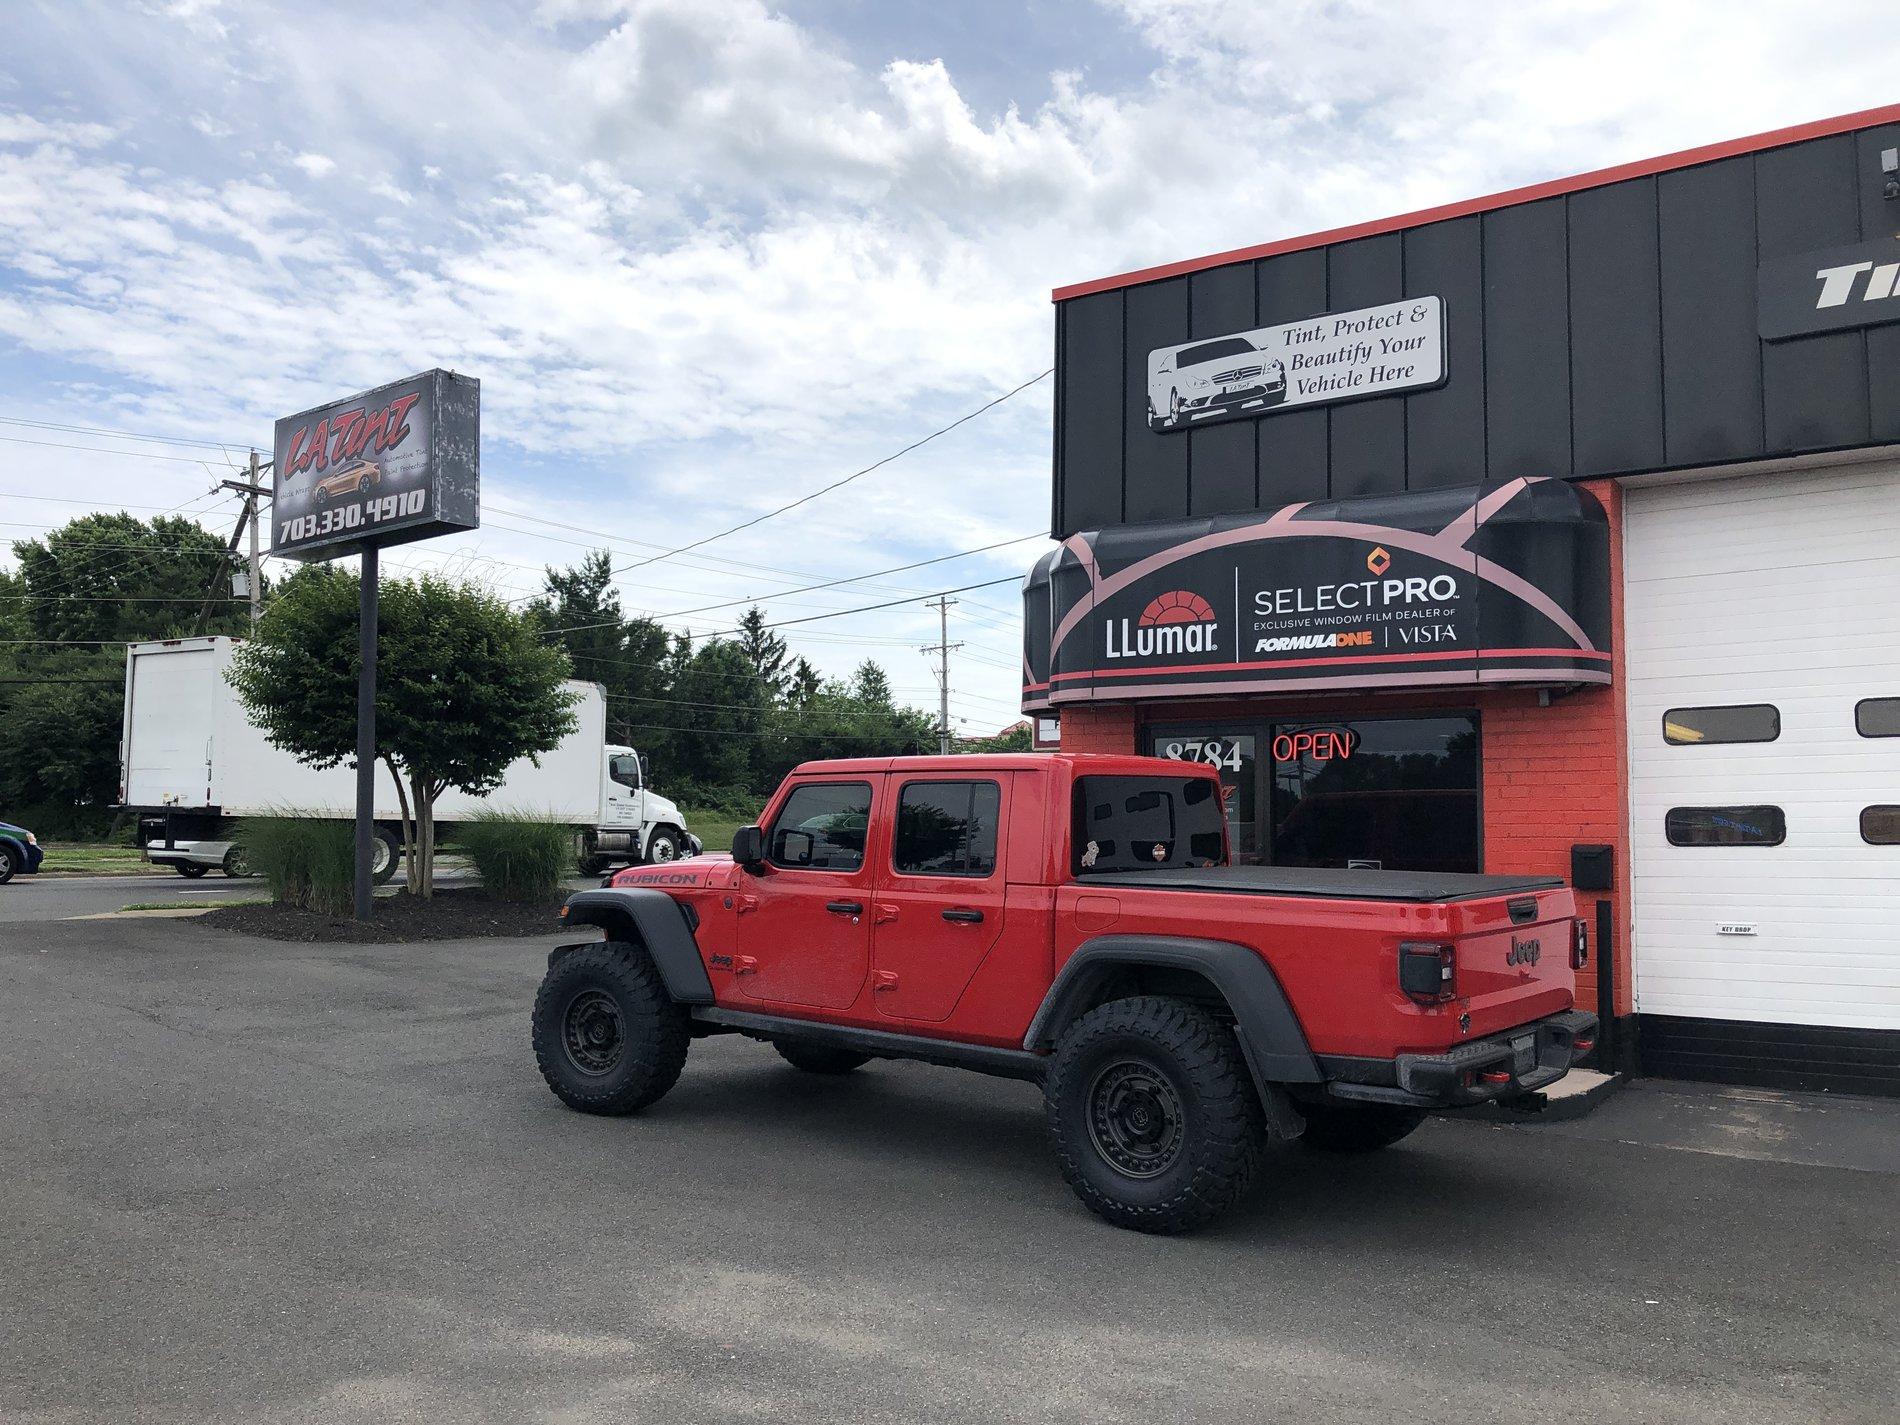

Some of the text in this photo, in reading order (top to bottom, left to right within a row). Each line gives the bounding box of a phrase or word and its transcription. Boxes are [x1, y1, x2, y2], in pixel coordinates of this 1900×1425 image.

[1816, 261, 1900, 309] TI
[1282, 304, 1428, 347] Tint, Protect &
[1291, 335, 1426, 371] Beautify Your
[1296, 364, 1415, 396] Vehicle Here
[1254, 608, 1456, 631] EXCLUSIVE WINDOW FILM DEALER OF
[1399, 624, 1457, 644] VISTA
[1106, 618, 1218, 659] LLumar
[1166, 741, 1243, 772] 8784
[1273, 732, 1350, 761] OPEN
[617, 874, 697, 885] RUBICON
[1506, 935, 1541, 967] Jeep
